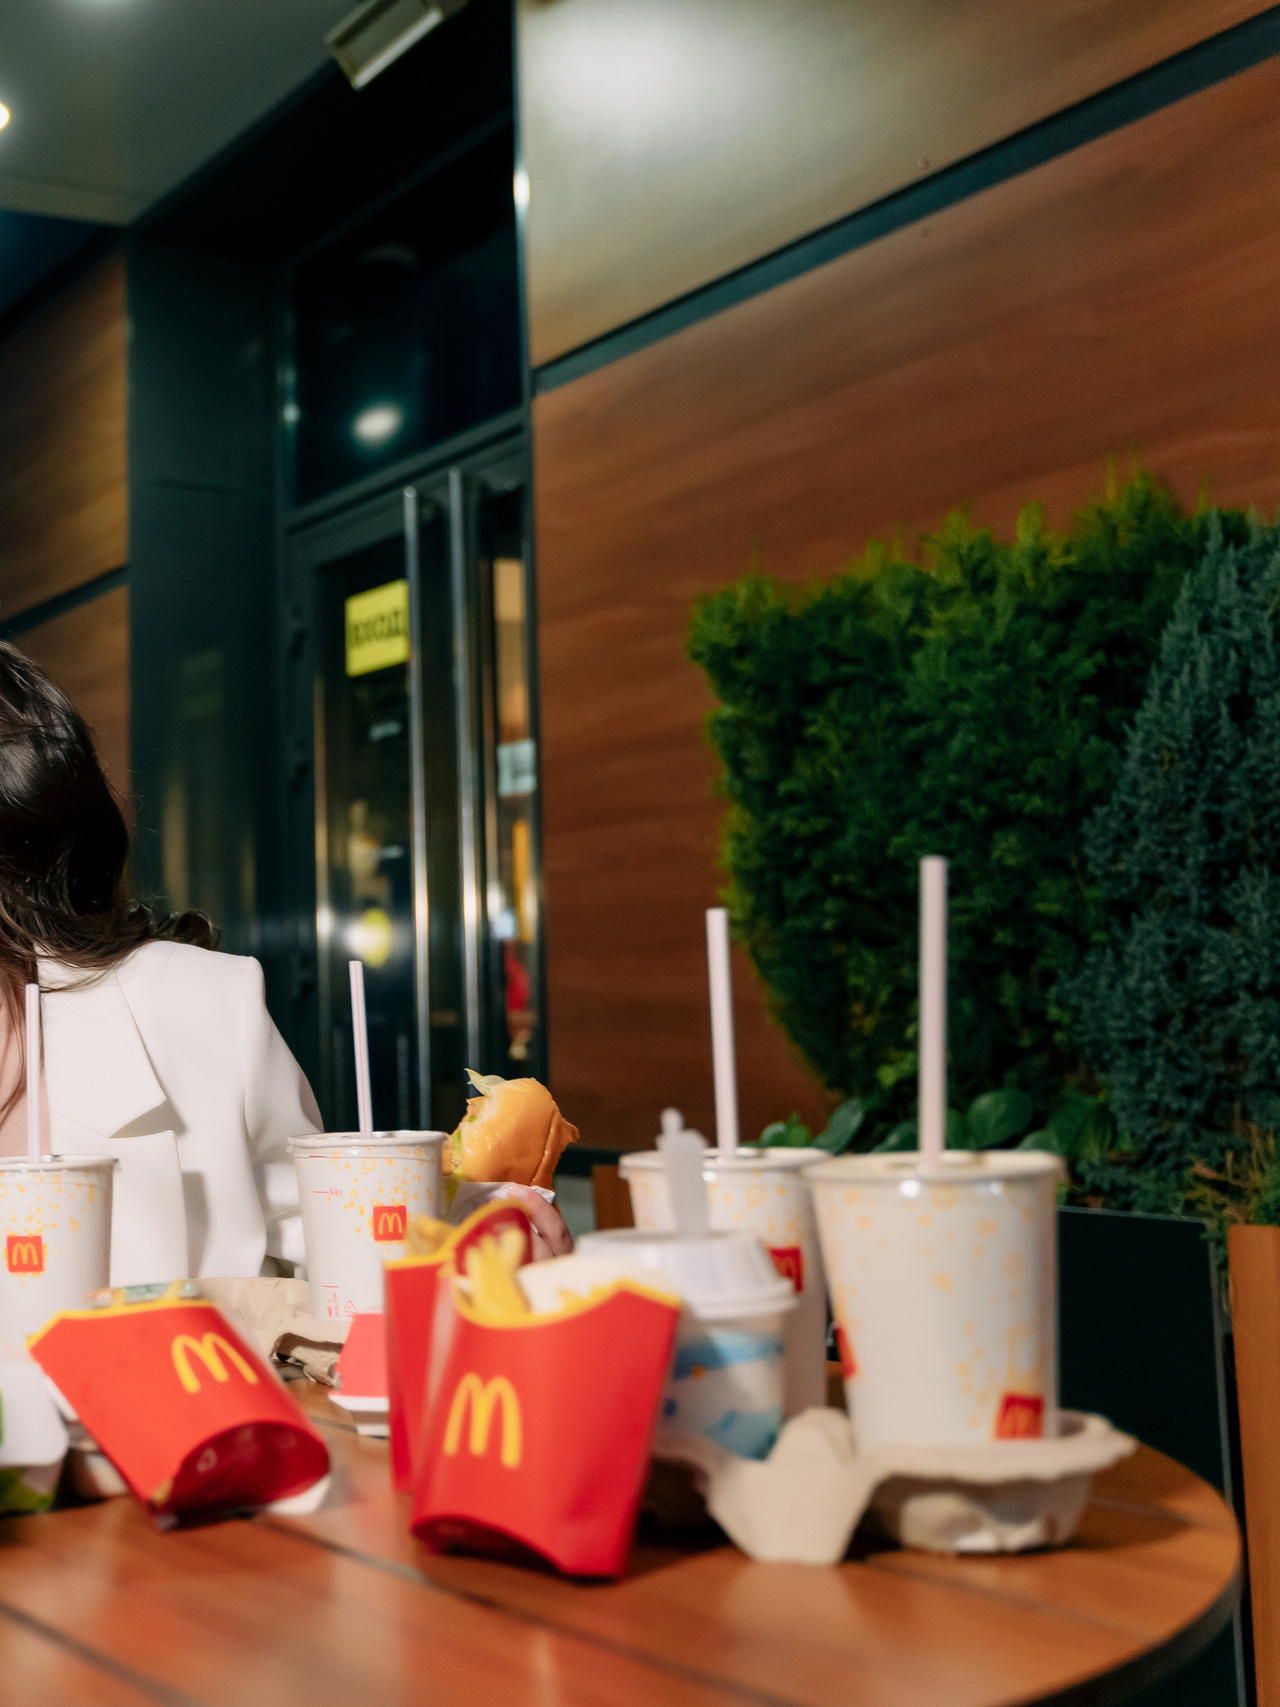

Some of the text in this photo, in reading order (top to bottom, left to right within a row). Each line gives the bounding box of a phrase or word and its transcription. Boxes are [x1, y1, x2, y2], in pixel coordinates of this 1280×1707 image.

[378, 1212, 403, 1235] M
[12, 1242, 39, 1266] M
[171, 1331, 258, 1394] M
[443, 1373, 521, 1468] M
